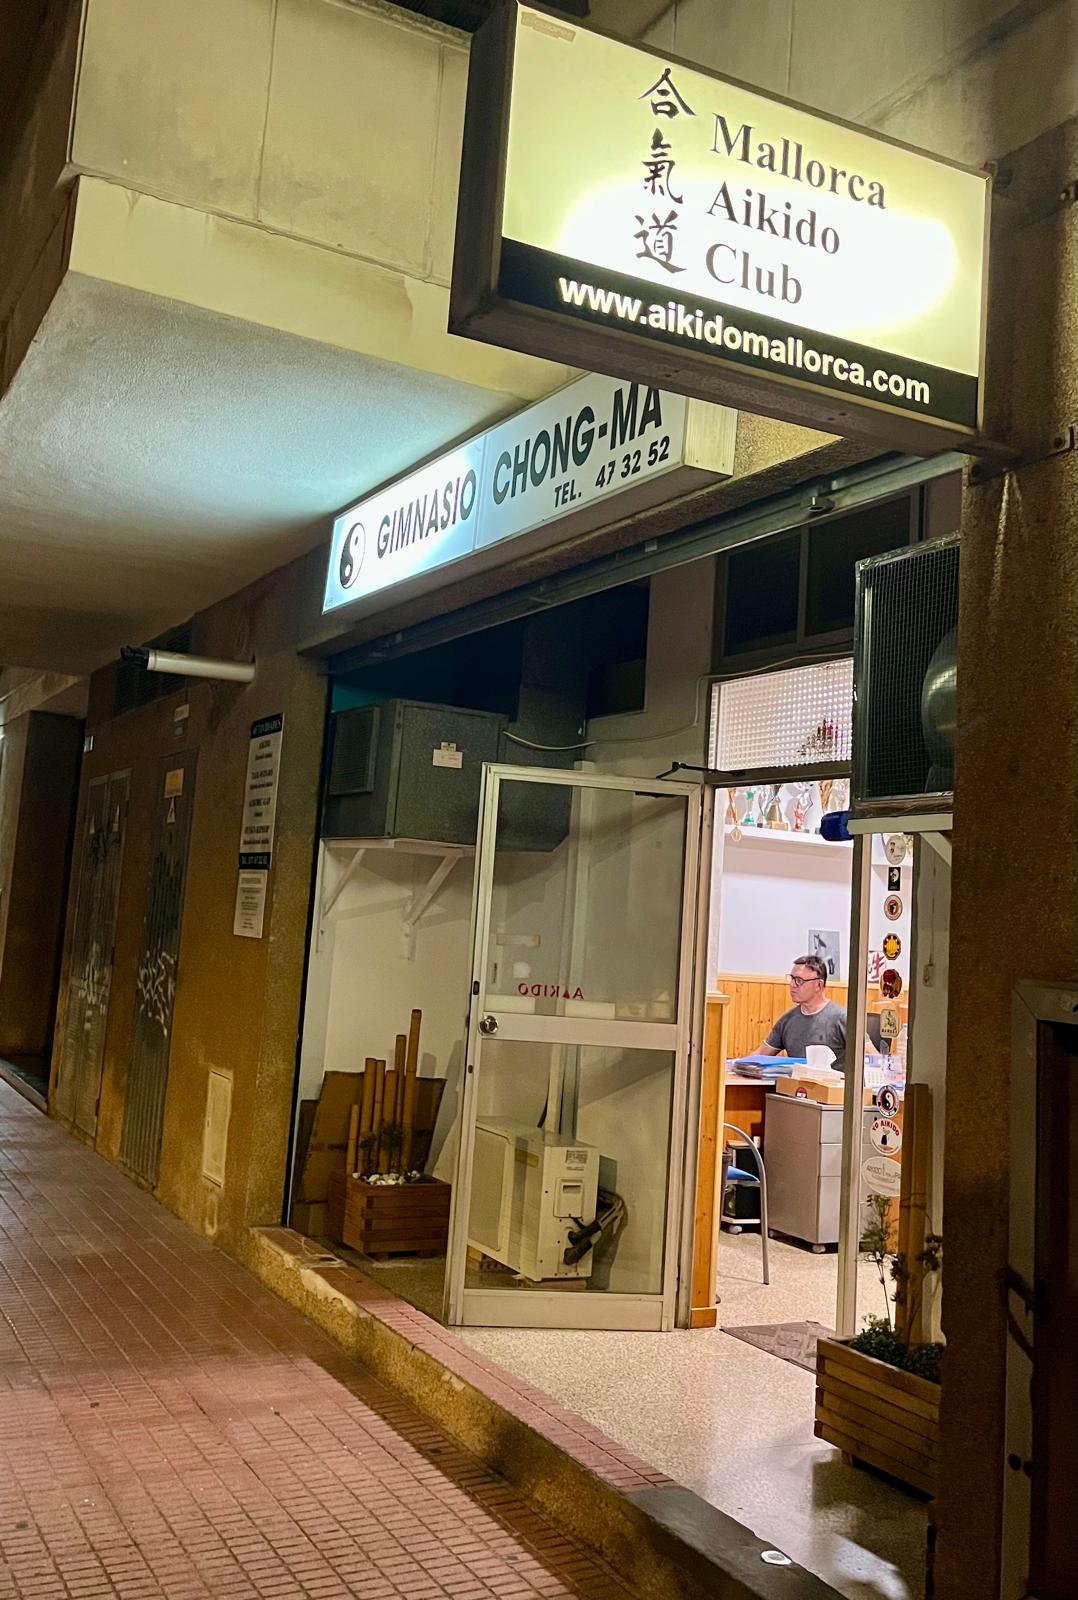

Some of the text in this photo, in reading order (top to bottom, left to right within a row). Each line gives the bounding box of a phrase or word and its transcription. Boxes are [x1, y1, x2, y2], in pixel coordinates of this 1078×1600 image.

[710, 114, 888, 210] Mallorca
[706, 181, 841, 255] Aikido
[705, 243, 804, 305] Club
[558, 275, 931, 405] www.aikidomallorca.com
[377, 382, 662, 559] GIMNASIO CHONG-MA
[554, 436, 671, 508] TEL. 47 32 52
